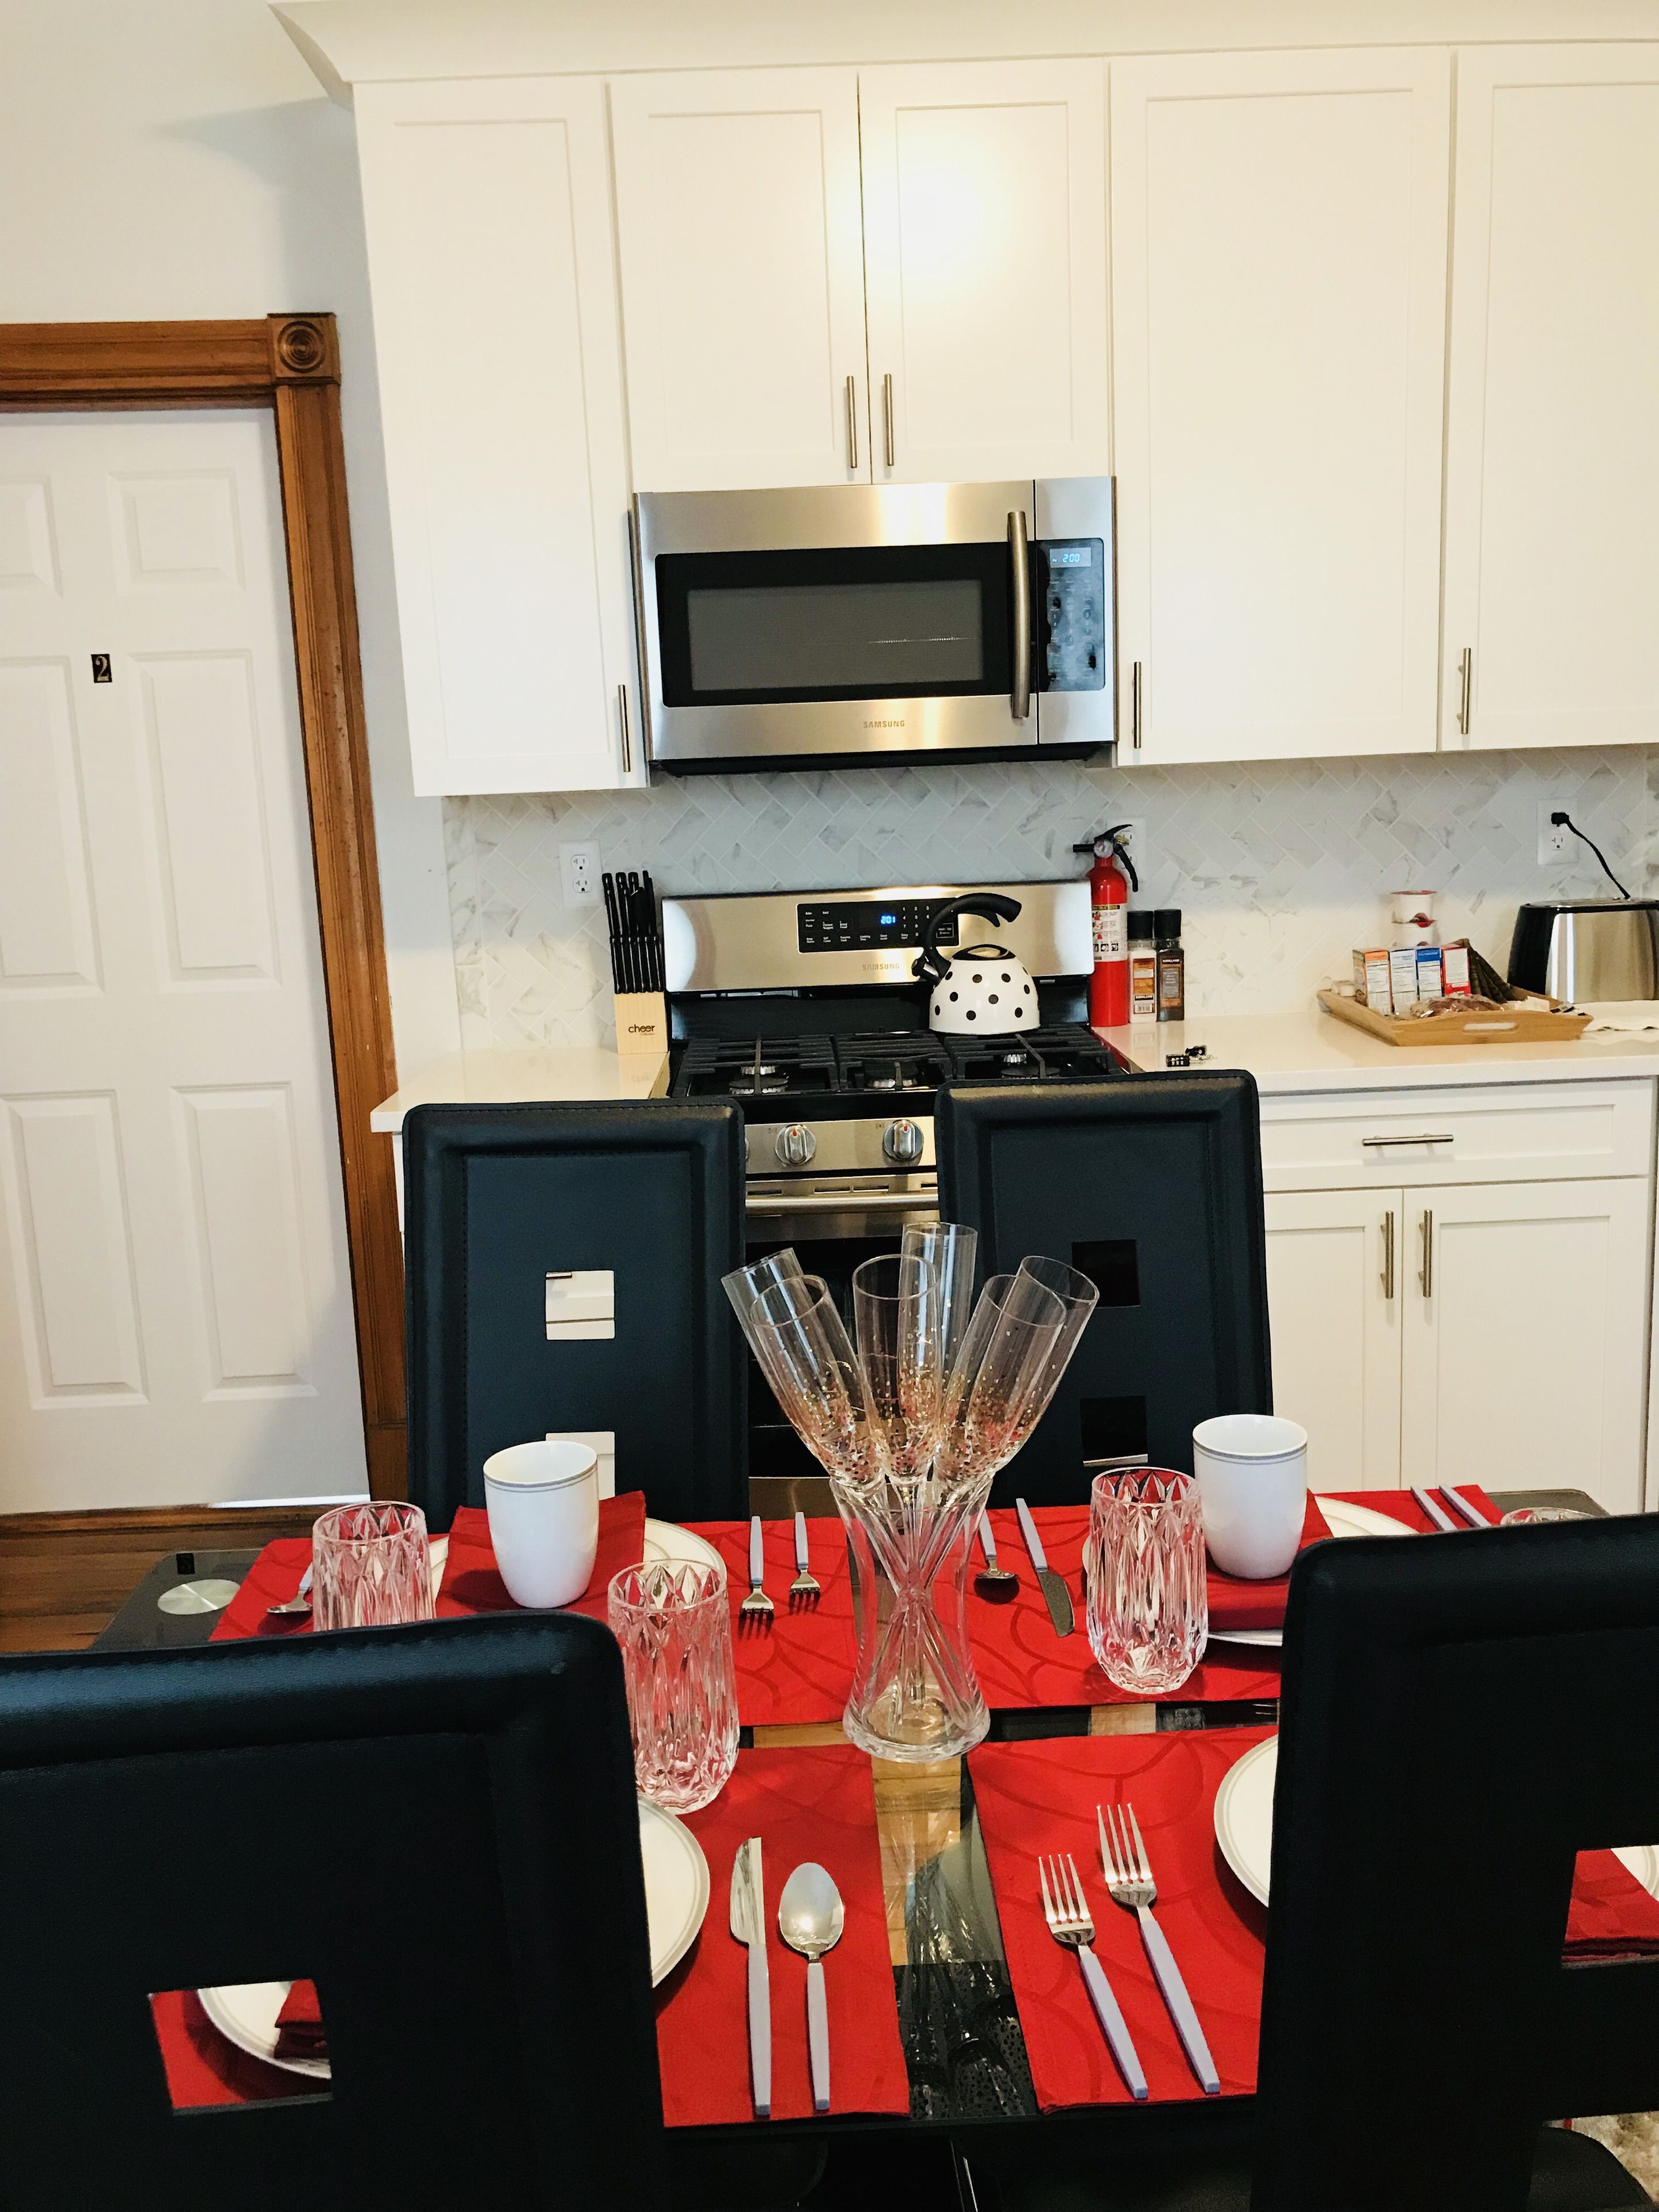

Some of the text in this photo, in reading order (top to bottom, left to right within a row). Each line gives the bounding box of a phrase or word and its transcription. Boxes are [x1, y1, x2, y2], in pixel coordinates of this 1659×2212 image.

[96, 656, 109, 681] 2
[863, 720, 905, 729] SAMSUNG
[628, 1024, 656, 1033] cheer
